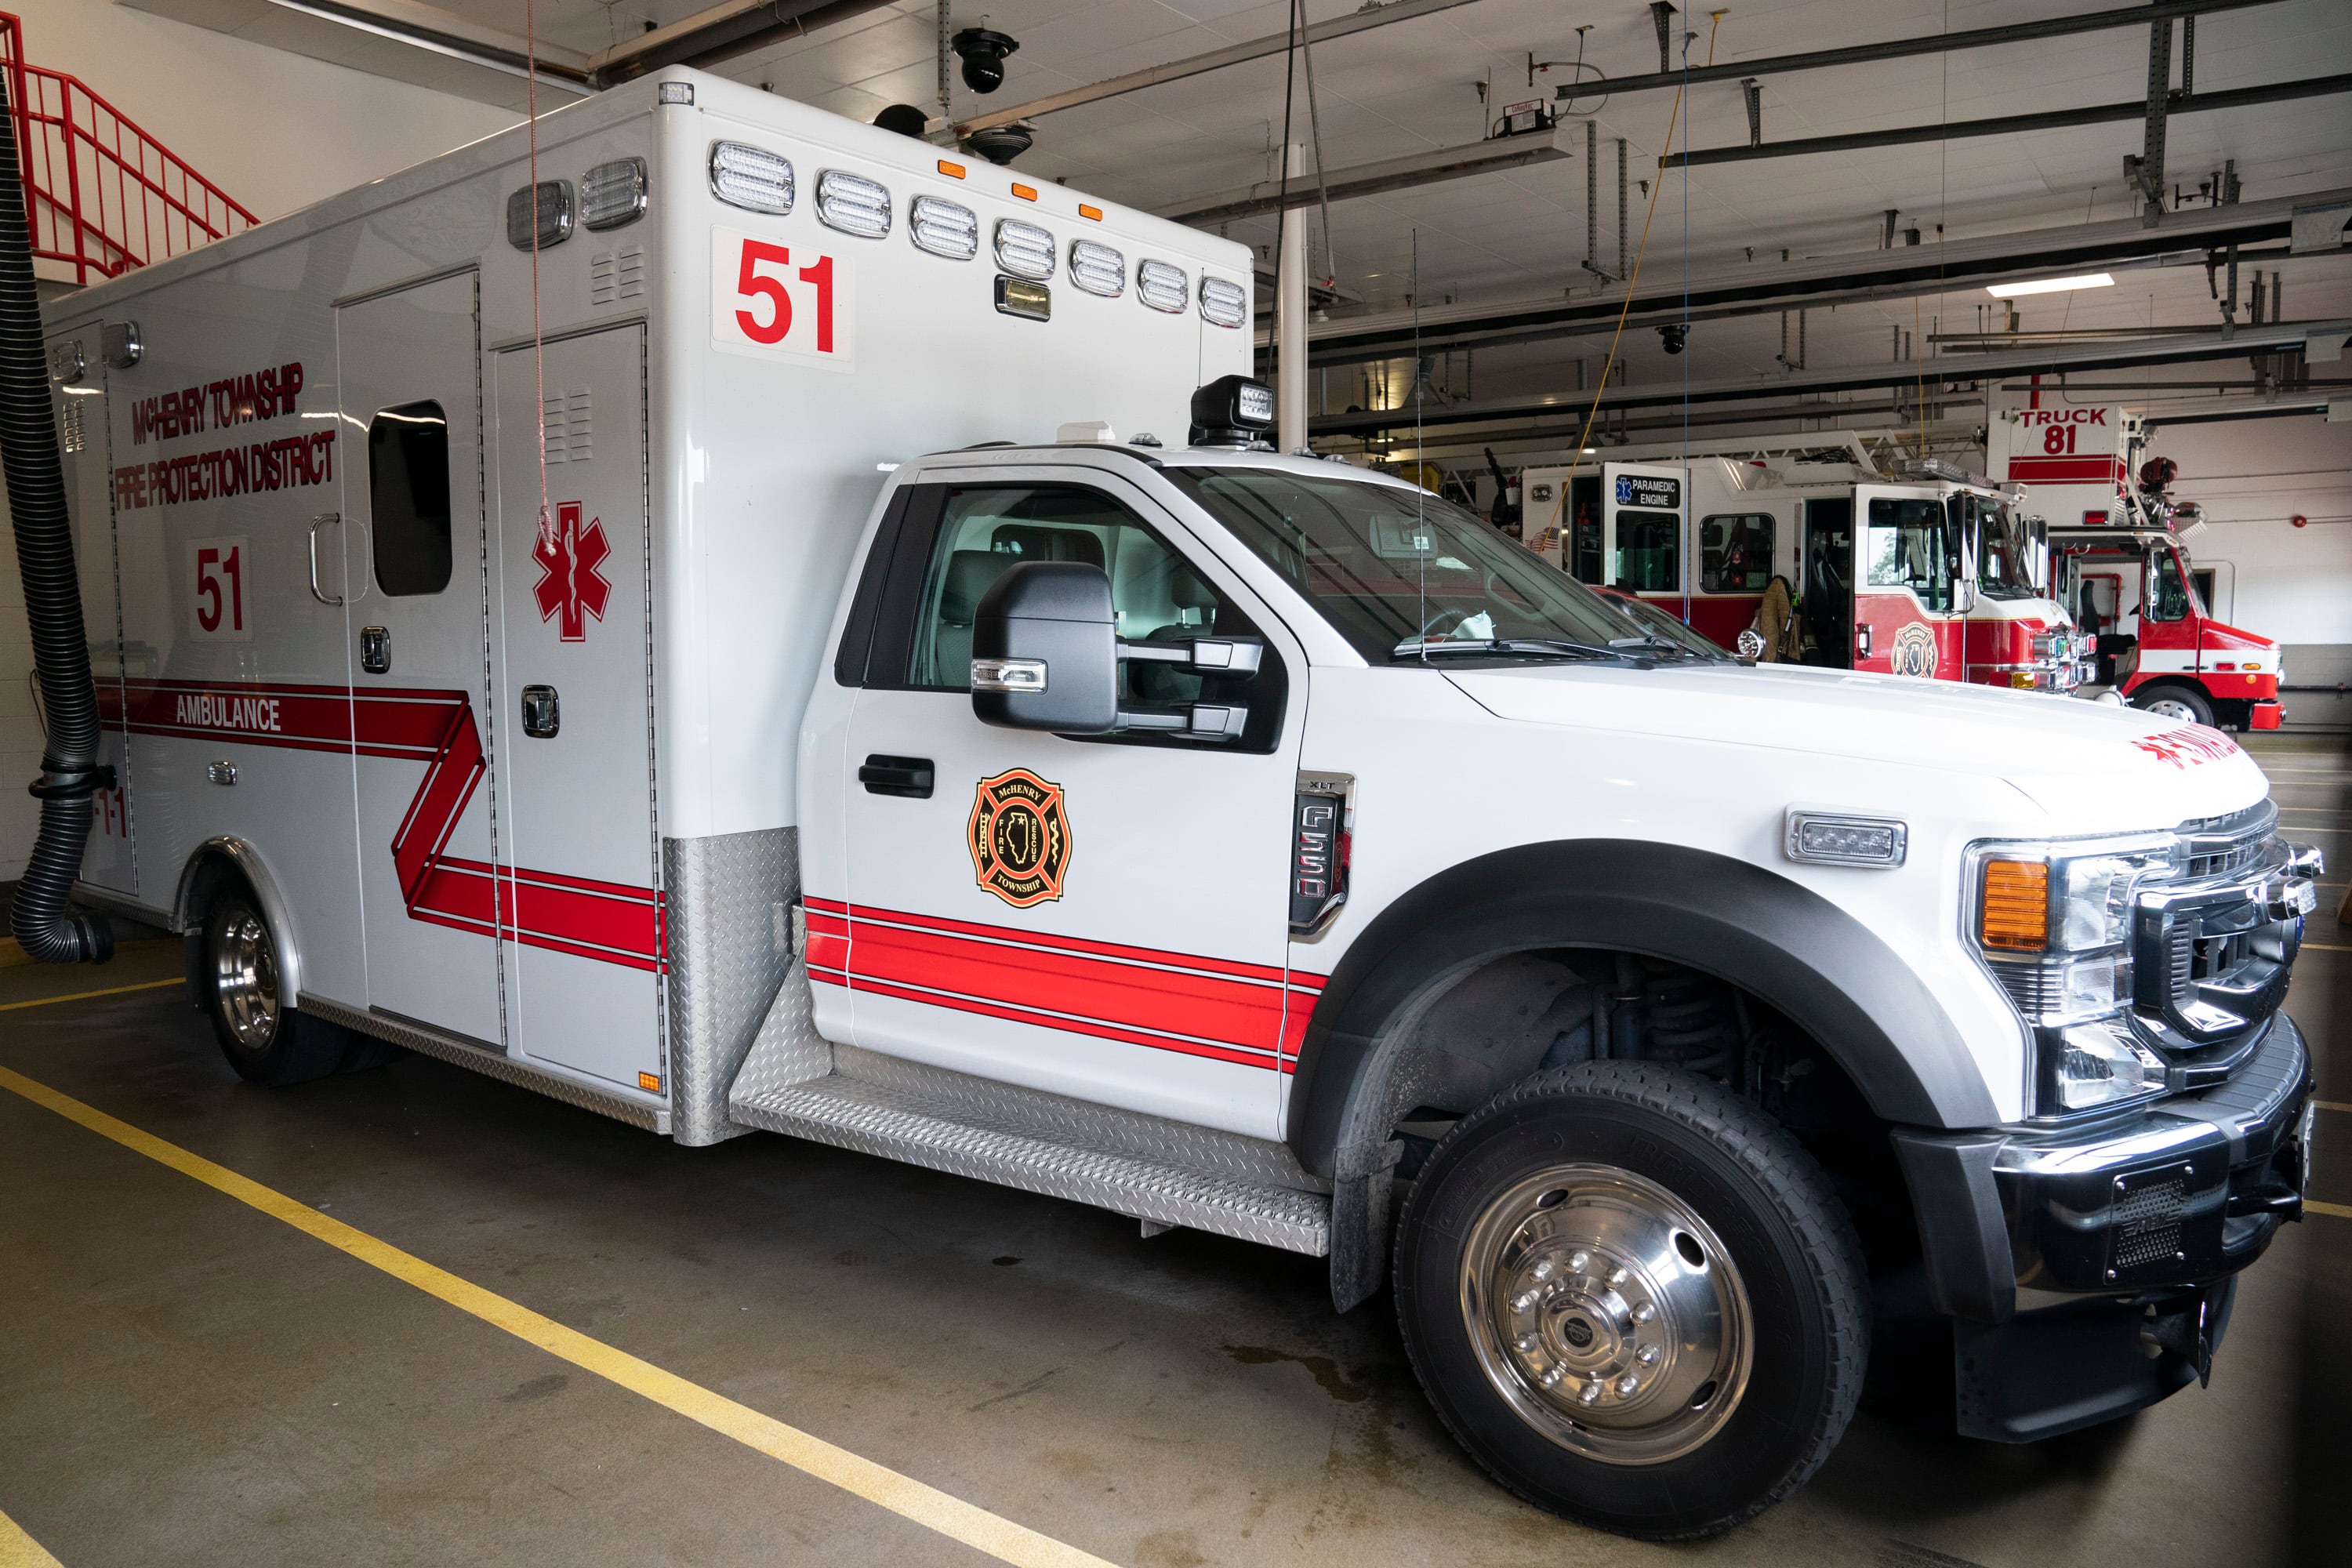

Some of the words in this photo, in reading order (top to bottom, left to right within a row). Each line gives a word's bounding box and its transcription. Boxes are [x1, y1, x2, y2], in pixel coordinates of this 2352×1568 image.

[735, 238, 833, 353] 51
[209, 361, 304, 429] TOWNSHIP
[2019, 408, 2108, 428] TRUCK
[2043, 424, 2077, 455] 81
[114, 463, 147, 511] FIRE
[148, 445, 250, 506] PROTECTION
[251, 430, 336, 494] DISTRICT
[1632, 479, 1675, 493] PARAMEDIC
[1640, 493, 1668, 506] ENGINE
[197, 546, 243, 632] 51
[176, 695, 281, 732] AMBULANCE
[998, 784, 1041, 801] McHENRY
[1309, 780, 1336, 790] XLT
[94, 786, 127, 839] -1-1
[997, 873, 1041, 893] TOWNSHIP
